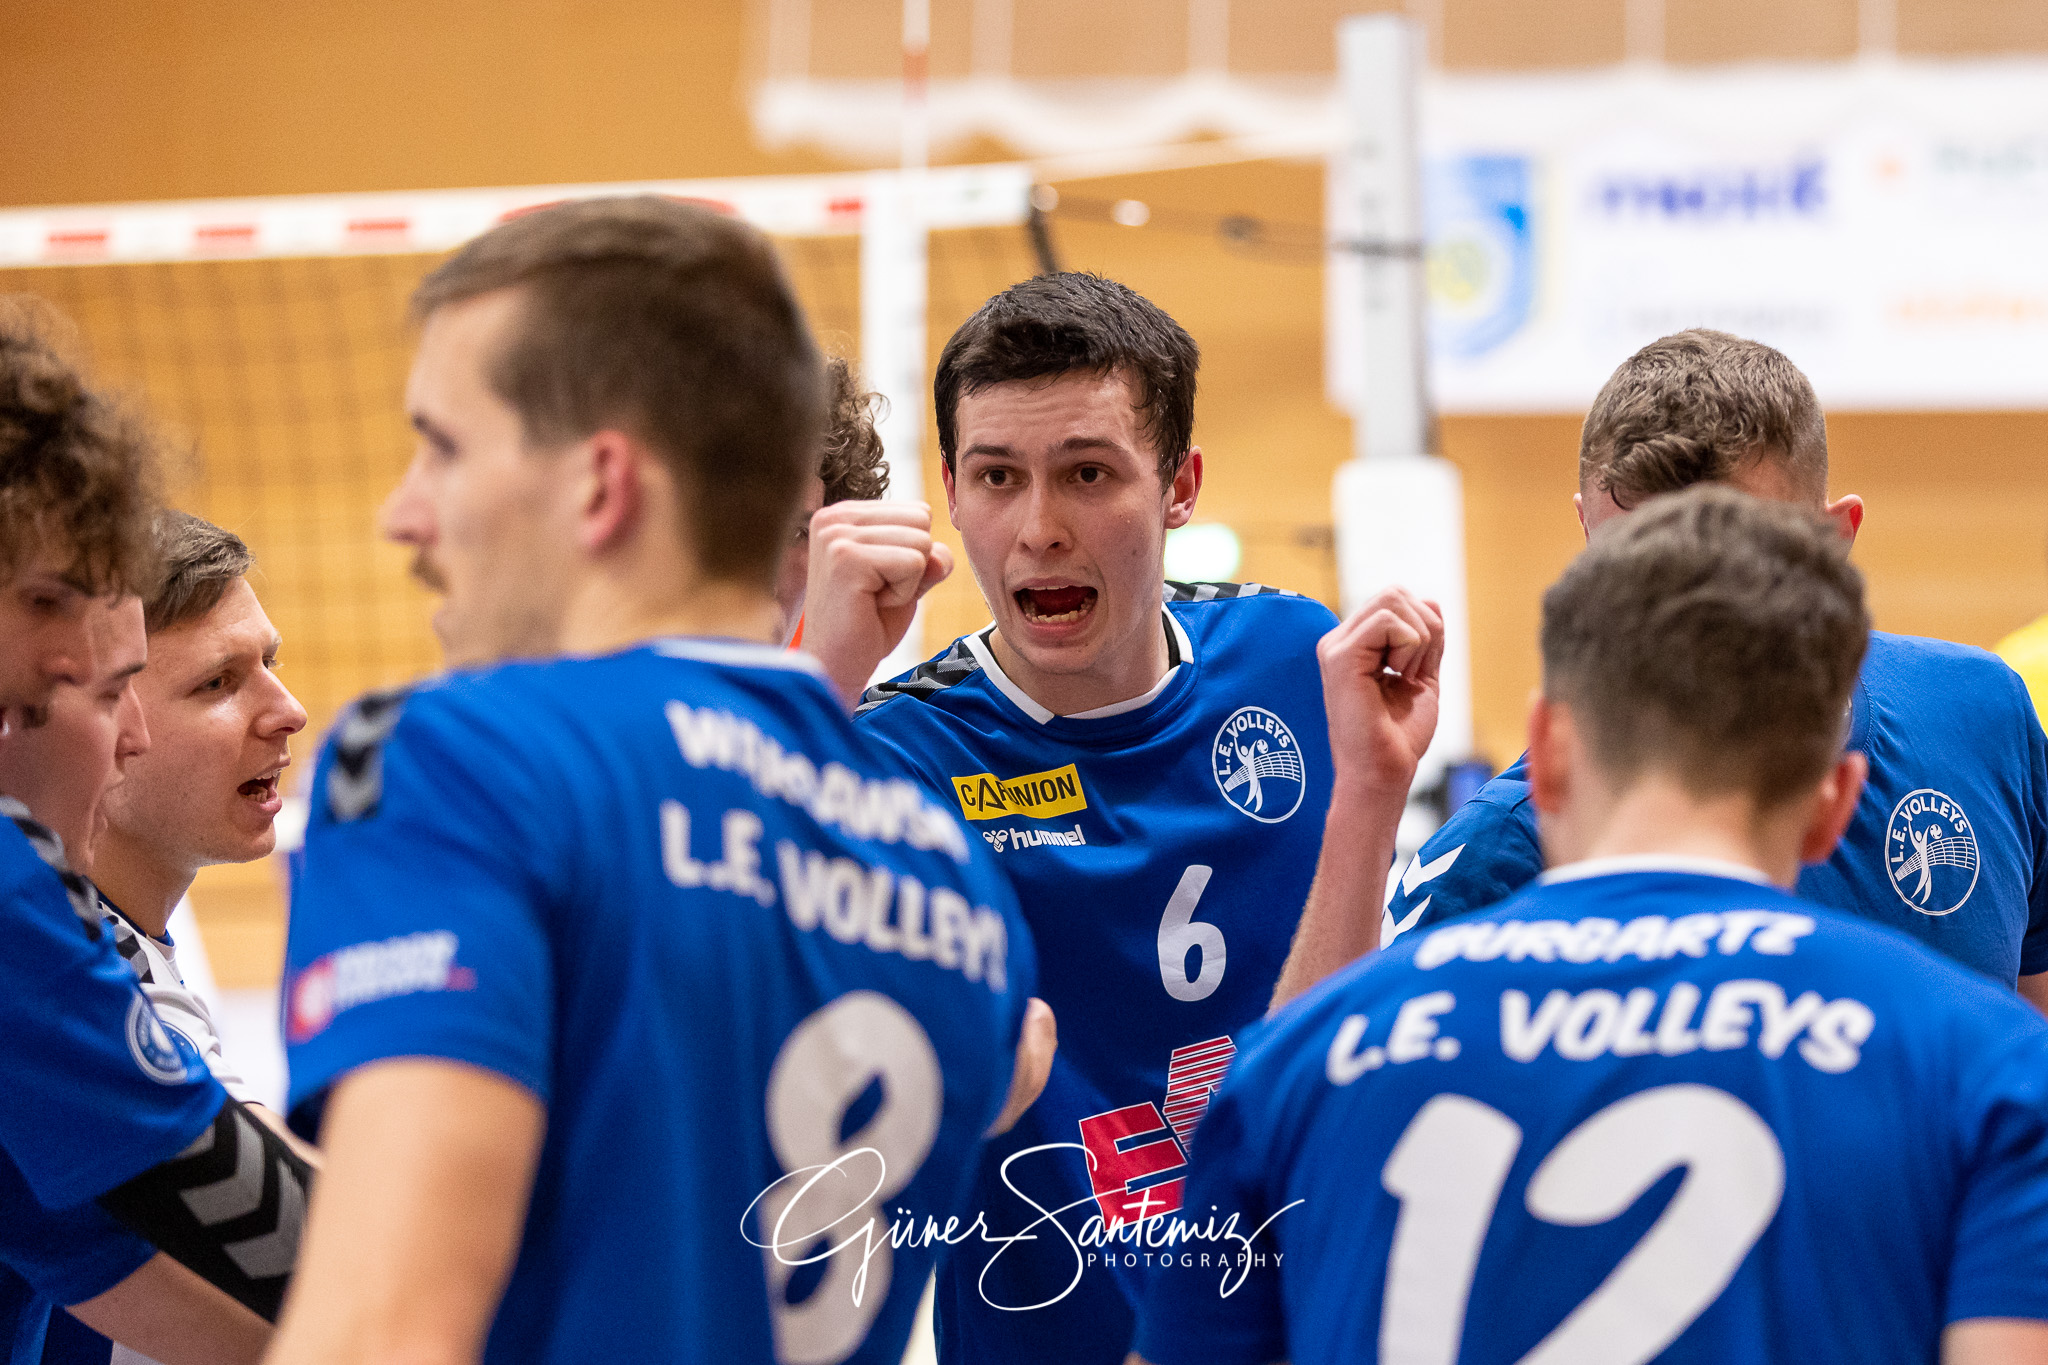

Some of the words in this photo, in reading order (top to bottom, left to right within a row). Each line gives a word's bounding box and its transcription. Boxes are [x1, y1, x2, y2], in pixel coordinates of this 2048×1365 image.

[1226, 712, 1291, 749] VOLLEYS
[1009, 823, 1087, 850] hummel
[1899, 796, 1968, 833] VOLLEYS
[1157, 864, 1227, 1002] 6
[1324, 989, 1462, 1086] L.E.
[1499, 977, 1876, 1075] VOLLEYS
[764, 989, 945, 1364] 8
[1377, 1082, 1787, 1365] 12
